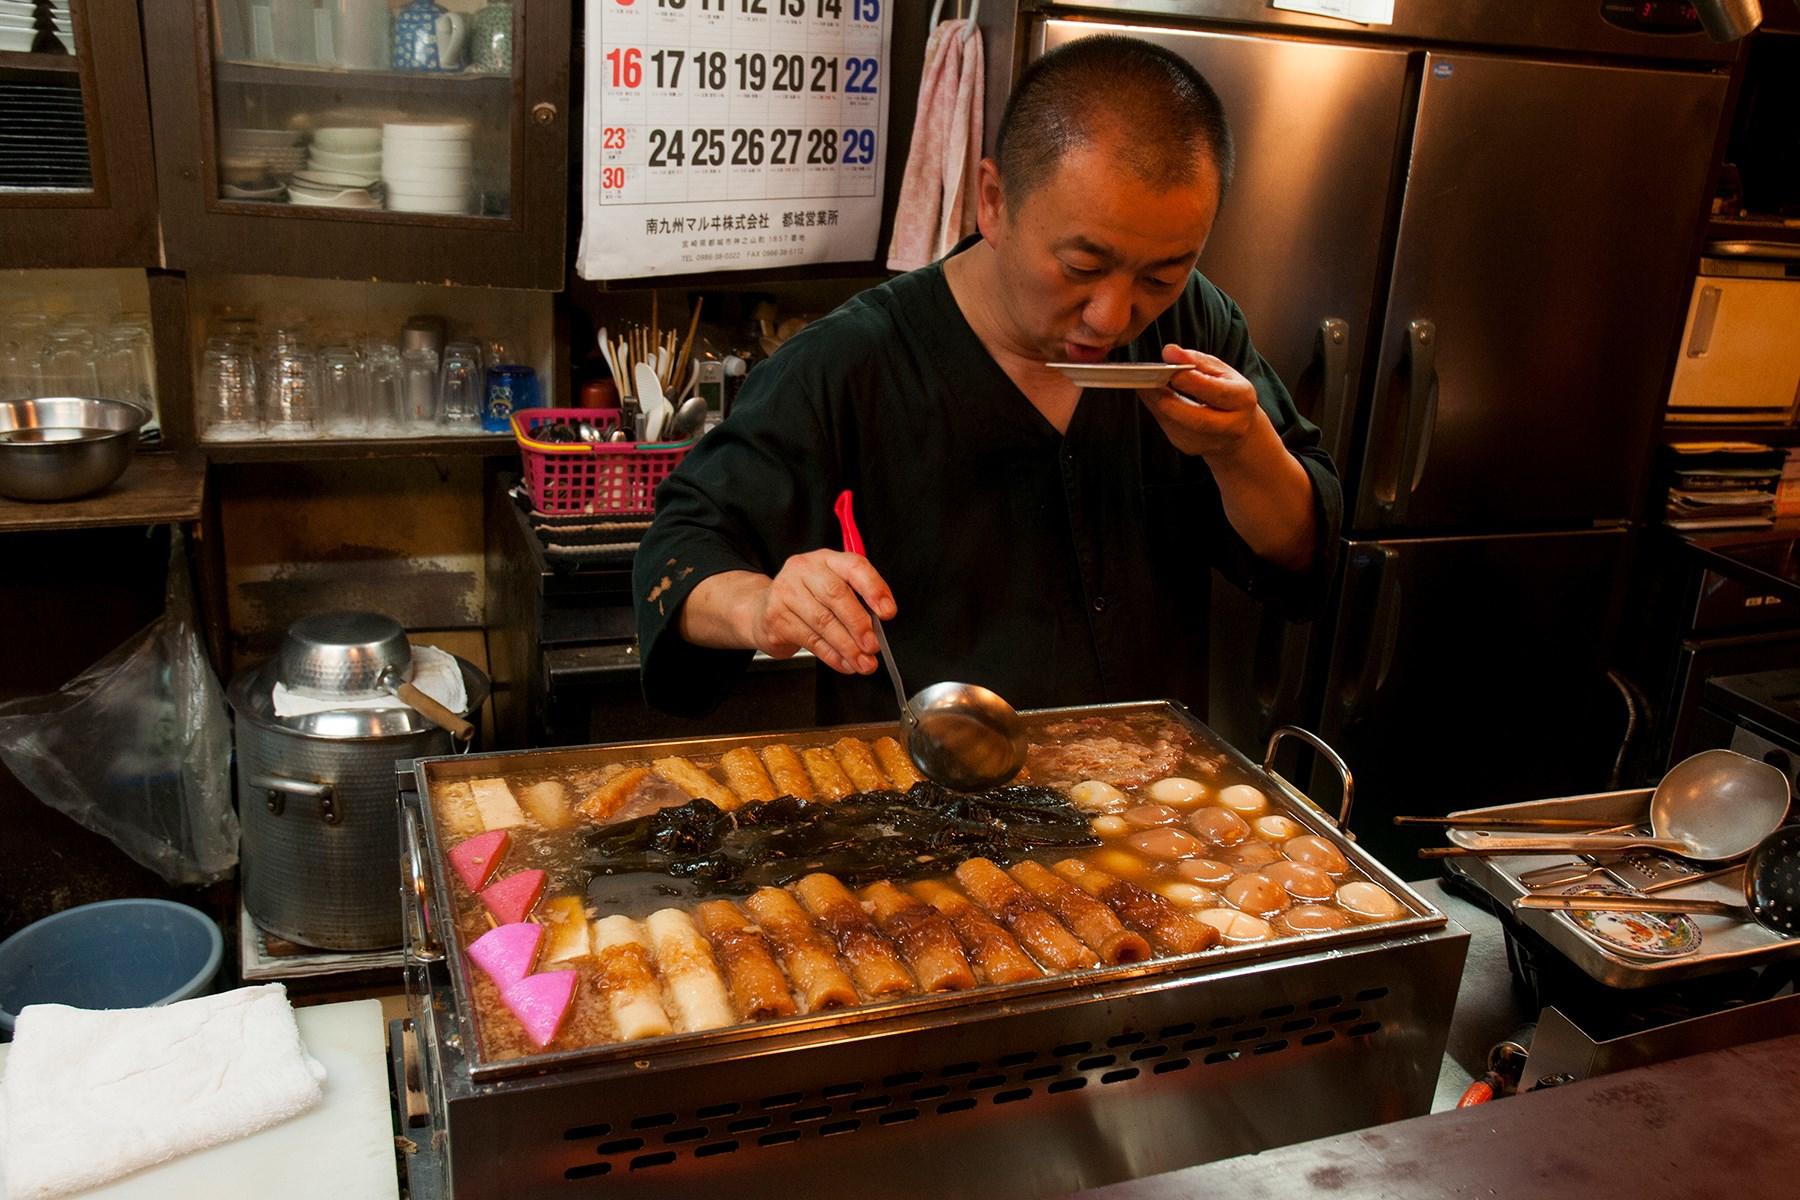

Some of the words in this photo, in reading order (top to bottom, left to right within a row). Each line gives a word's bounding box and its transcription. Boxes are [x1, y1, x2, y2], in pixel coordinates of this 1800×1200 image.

[607, 48, 642, 88] 16
[651, 50, 685, 89] 17
[693, 51, 727, 90] 18
[734, 53, 766, 92] 19
[772, 54, 805, 93] 20
[810, 55, 839, 94] 21
[844, 57, 879, 94] 22
[603, 127, 625, 149] 23
[648, 129, 685, 167] 24
[691, 128, 726, 166] 25
[731, 128, 765, 166] 26
[770, 128, 803, 165] 27
[806, 128, 839, 165] 28
[841, 128, 876, 165] 29
[602, 167, 625, 189] 30
[782, 210, 839, 228] 都城営業所
